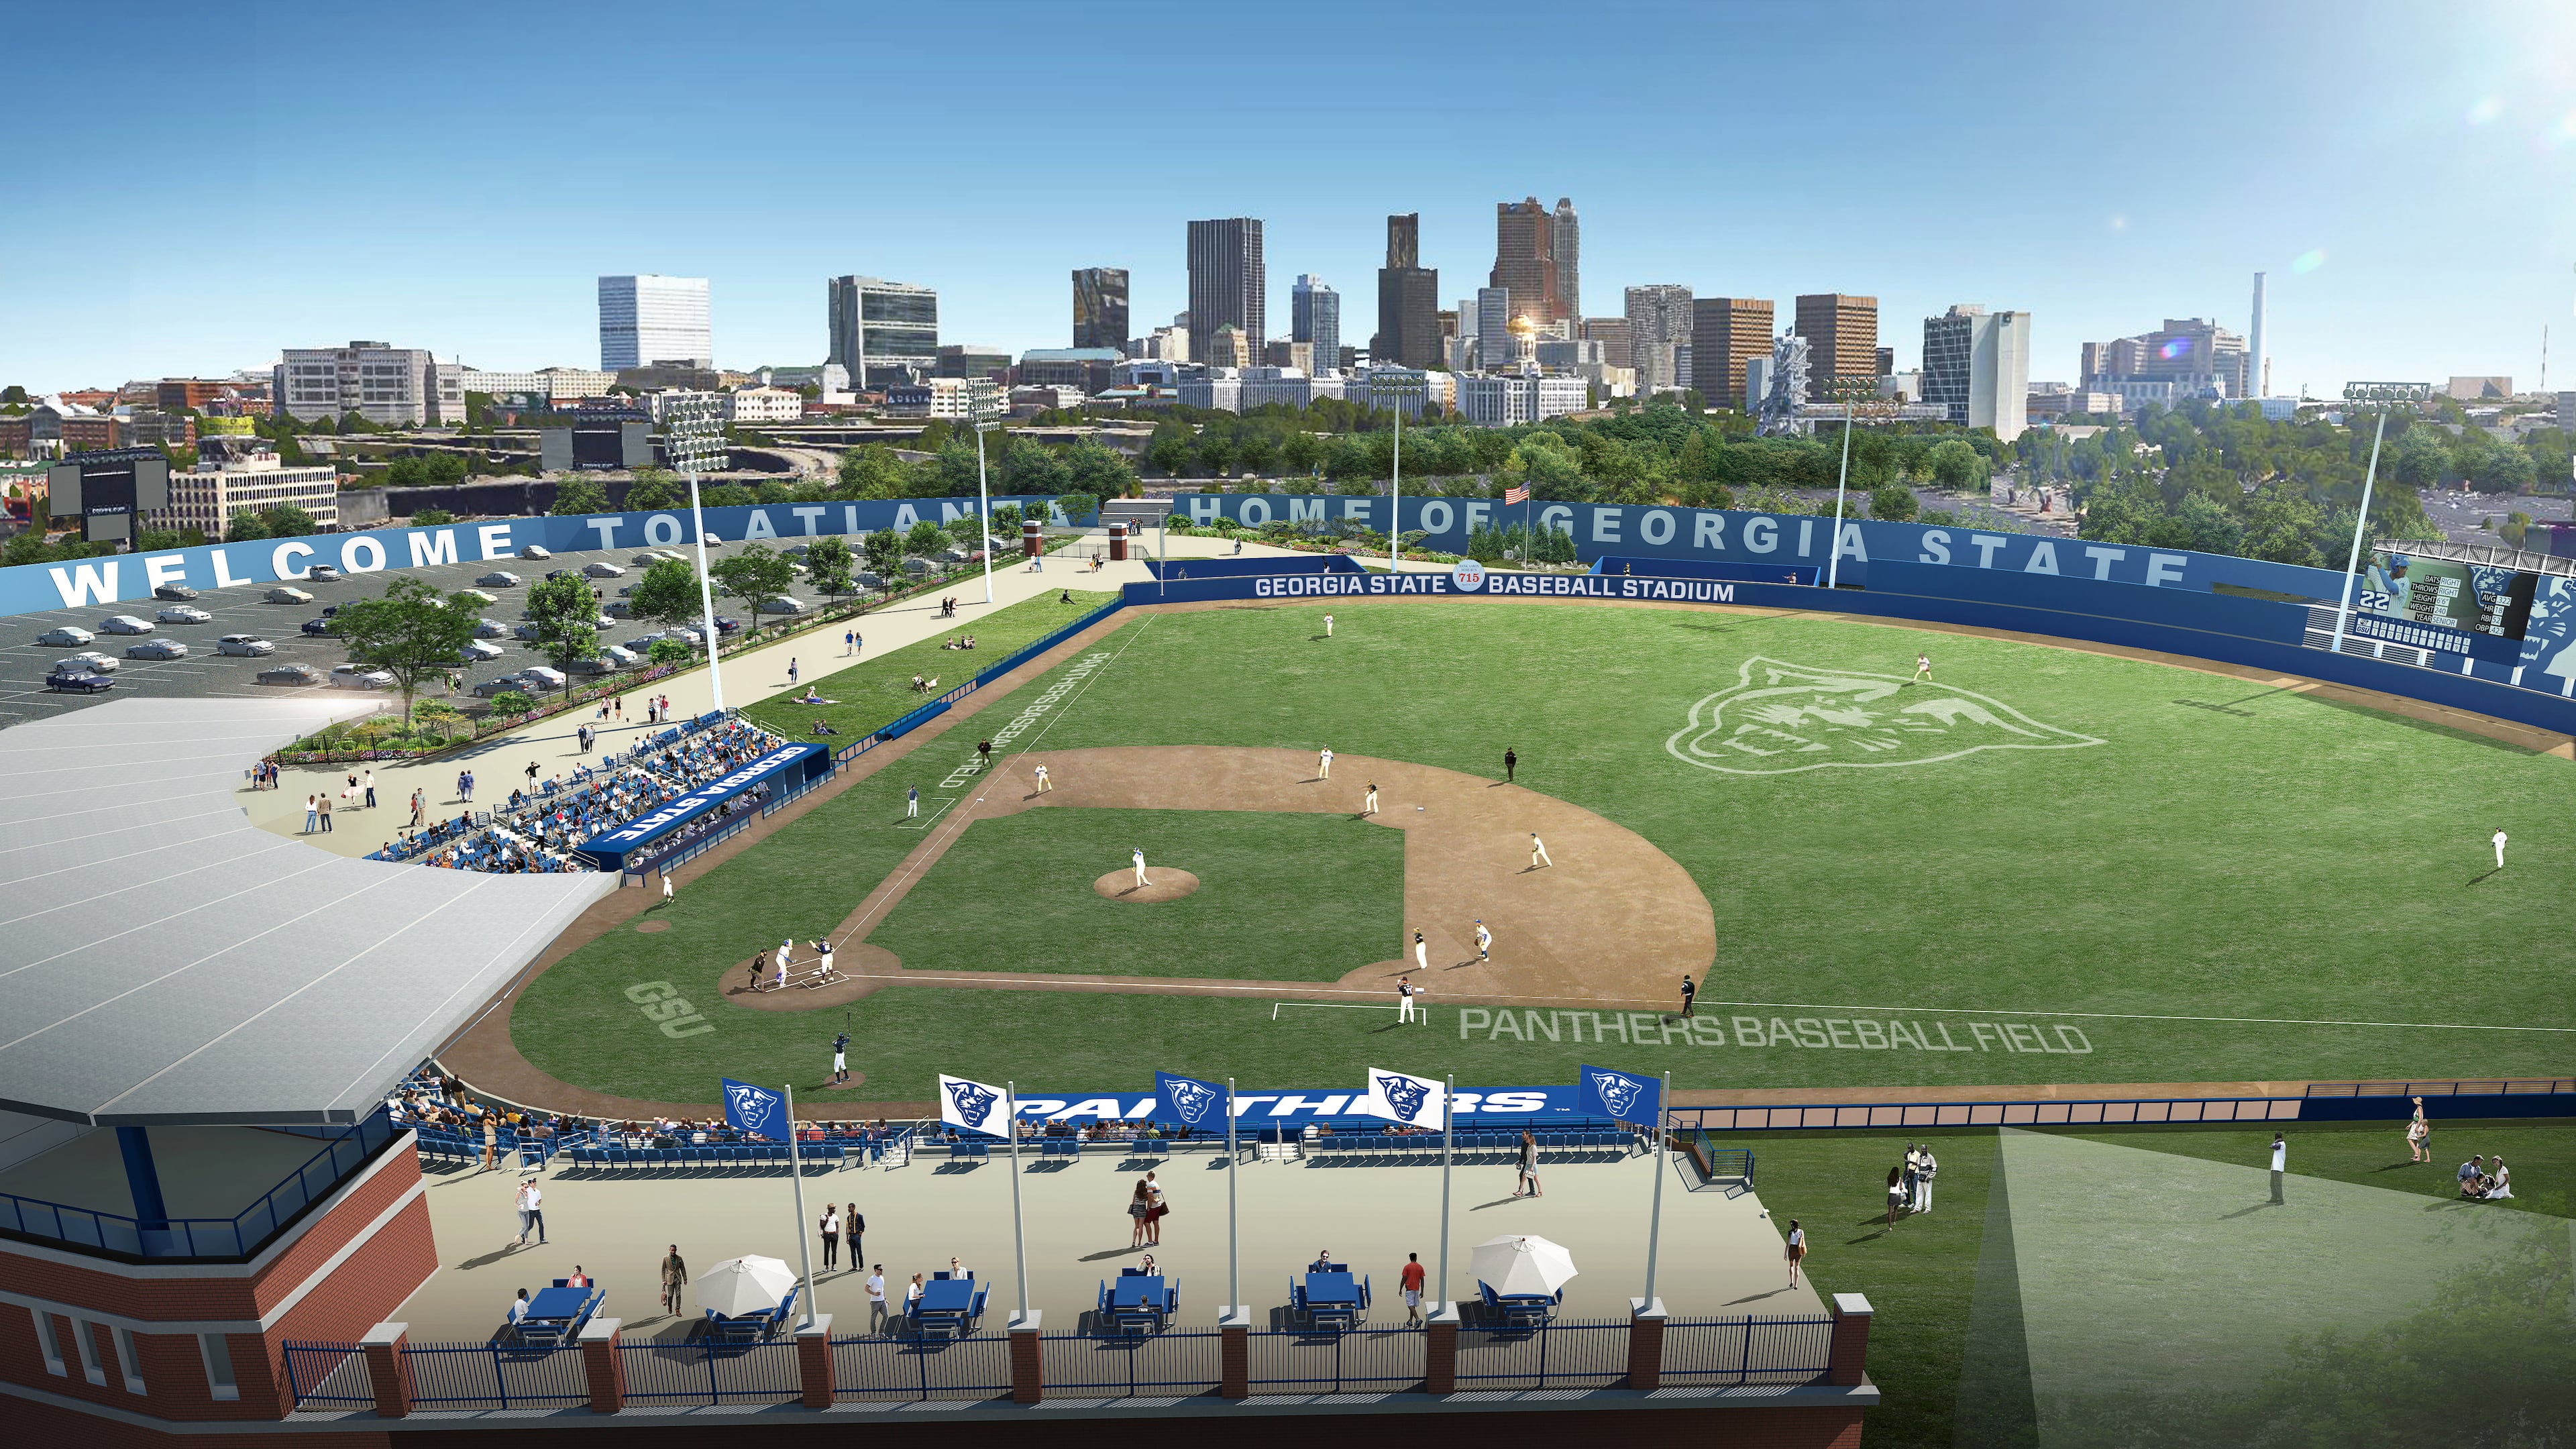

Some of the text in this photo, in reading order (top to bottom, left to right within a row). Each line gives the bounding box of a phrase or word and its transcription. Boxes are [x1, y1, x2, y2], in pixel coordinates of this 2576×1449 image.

[898, 392, 930, 402] DELTA
[1190, 497, 2188, 587] HOME OF GEORGIA STATE
[48, 525, 515, 608] WELCOME
[586, 514, 683, 549] TO
[1458, 573, 1480, 582] 715
[2424, 576, 2461, 587] BATS RIGHT
[1255, 576, 1734, 602] GEORGIA STATE BASEBALL STADIUM
[2412, 583, 2458, 596] THROWS RIGHT
[2360, 590, 2390, 610] 22
[2413, 593, 2436, 602] HEIGHT
[2482, 594, 2511, 605] AVG .322
[2410, 603, 2434, 612] WEIGHT
[2416, 613, 2456, 626] YEAR SENIOR
[2491, 616, 2501, 624] 52
[2475, 624, 2504, 635] OBP .423
[1034, 653, 1111, 704] PANTHERS
[939, 759, 989, 788] FIELD
[608, 747, 808, 841] GEORGIA STATE
[624, 981, 716, 1039] GSU
[1460, 1008, 2092, 1055] PANTHERS BASEBALL FIELD
[1008, 1092, 1547, 1120] PATHRS
